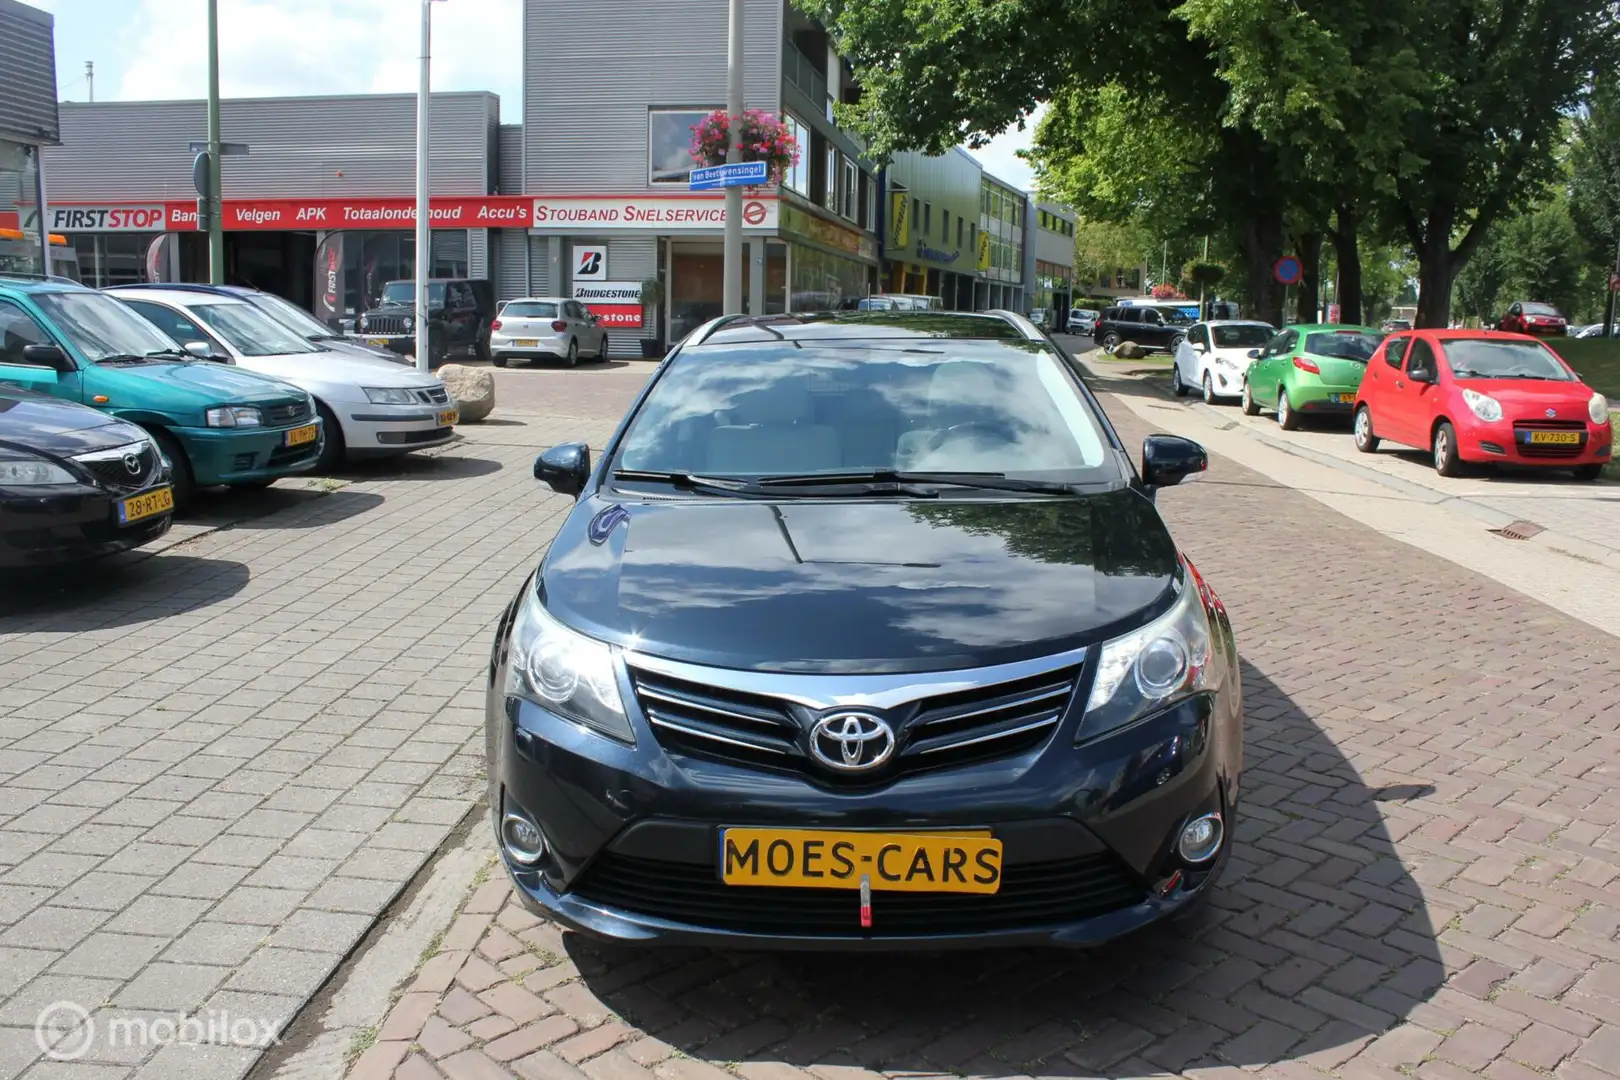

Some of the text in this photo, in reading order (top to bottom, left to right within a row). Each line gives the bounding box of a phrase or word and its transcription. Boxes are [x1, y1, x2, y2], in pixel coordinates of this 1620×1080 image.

[171, 205, 527, 224] Ban Velgen APK Totaalondeoud Accu's
[536, 205, 619, 221] STOUBAND
[575, 287, 641, 299] BRIDGESTONE
[725, 838, 1000, 885] MOES-CARS
